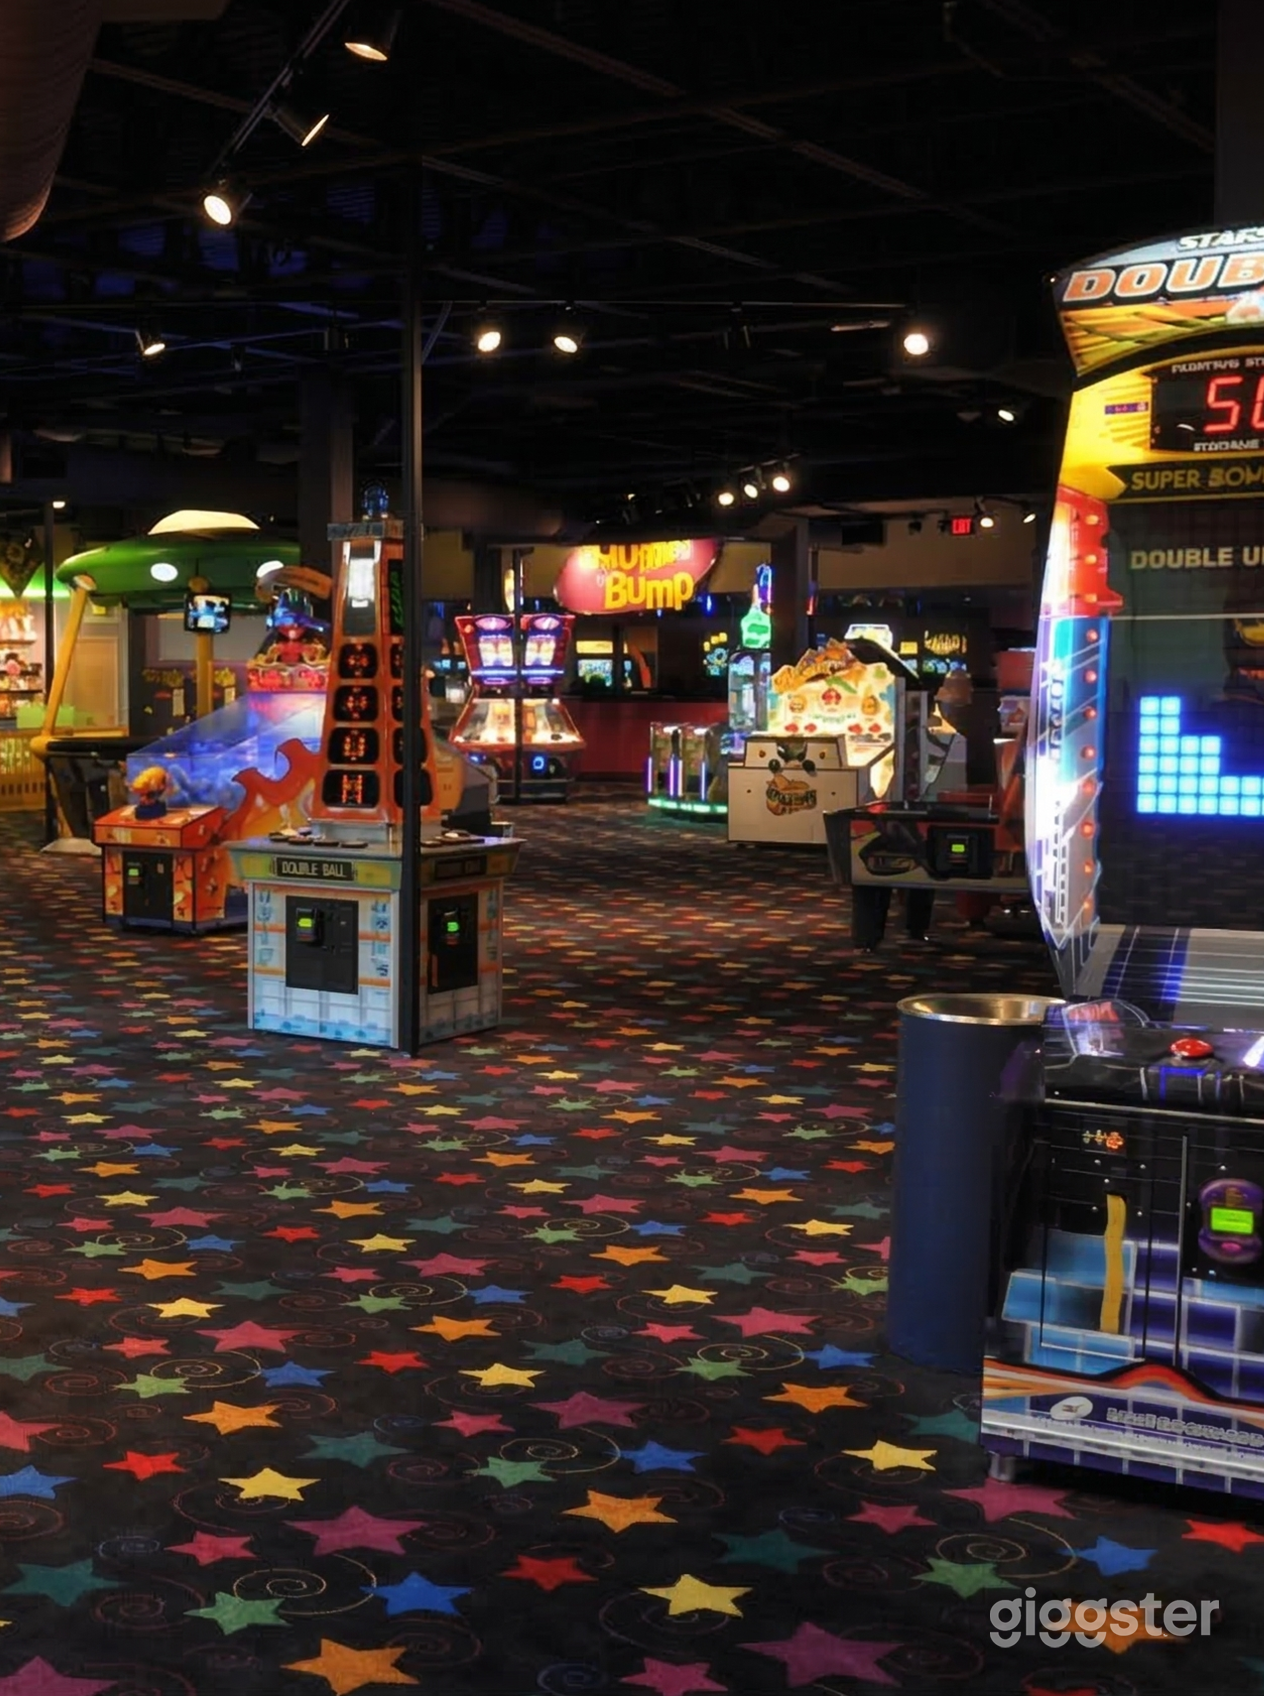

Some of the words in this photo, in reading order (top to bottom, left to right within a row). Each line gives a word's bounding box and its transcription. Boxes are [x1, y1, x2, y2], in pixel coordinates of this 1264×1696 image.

[1063, 252, 1264, 301] DOUB
[1131, 469, 1202, 490] SUPER
[1130, 547, 1234, 569] DOUBLE
[1243, 546, 1264, 567] U
